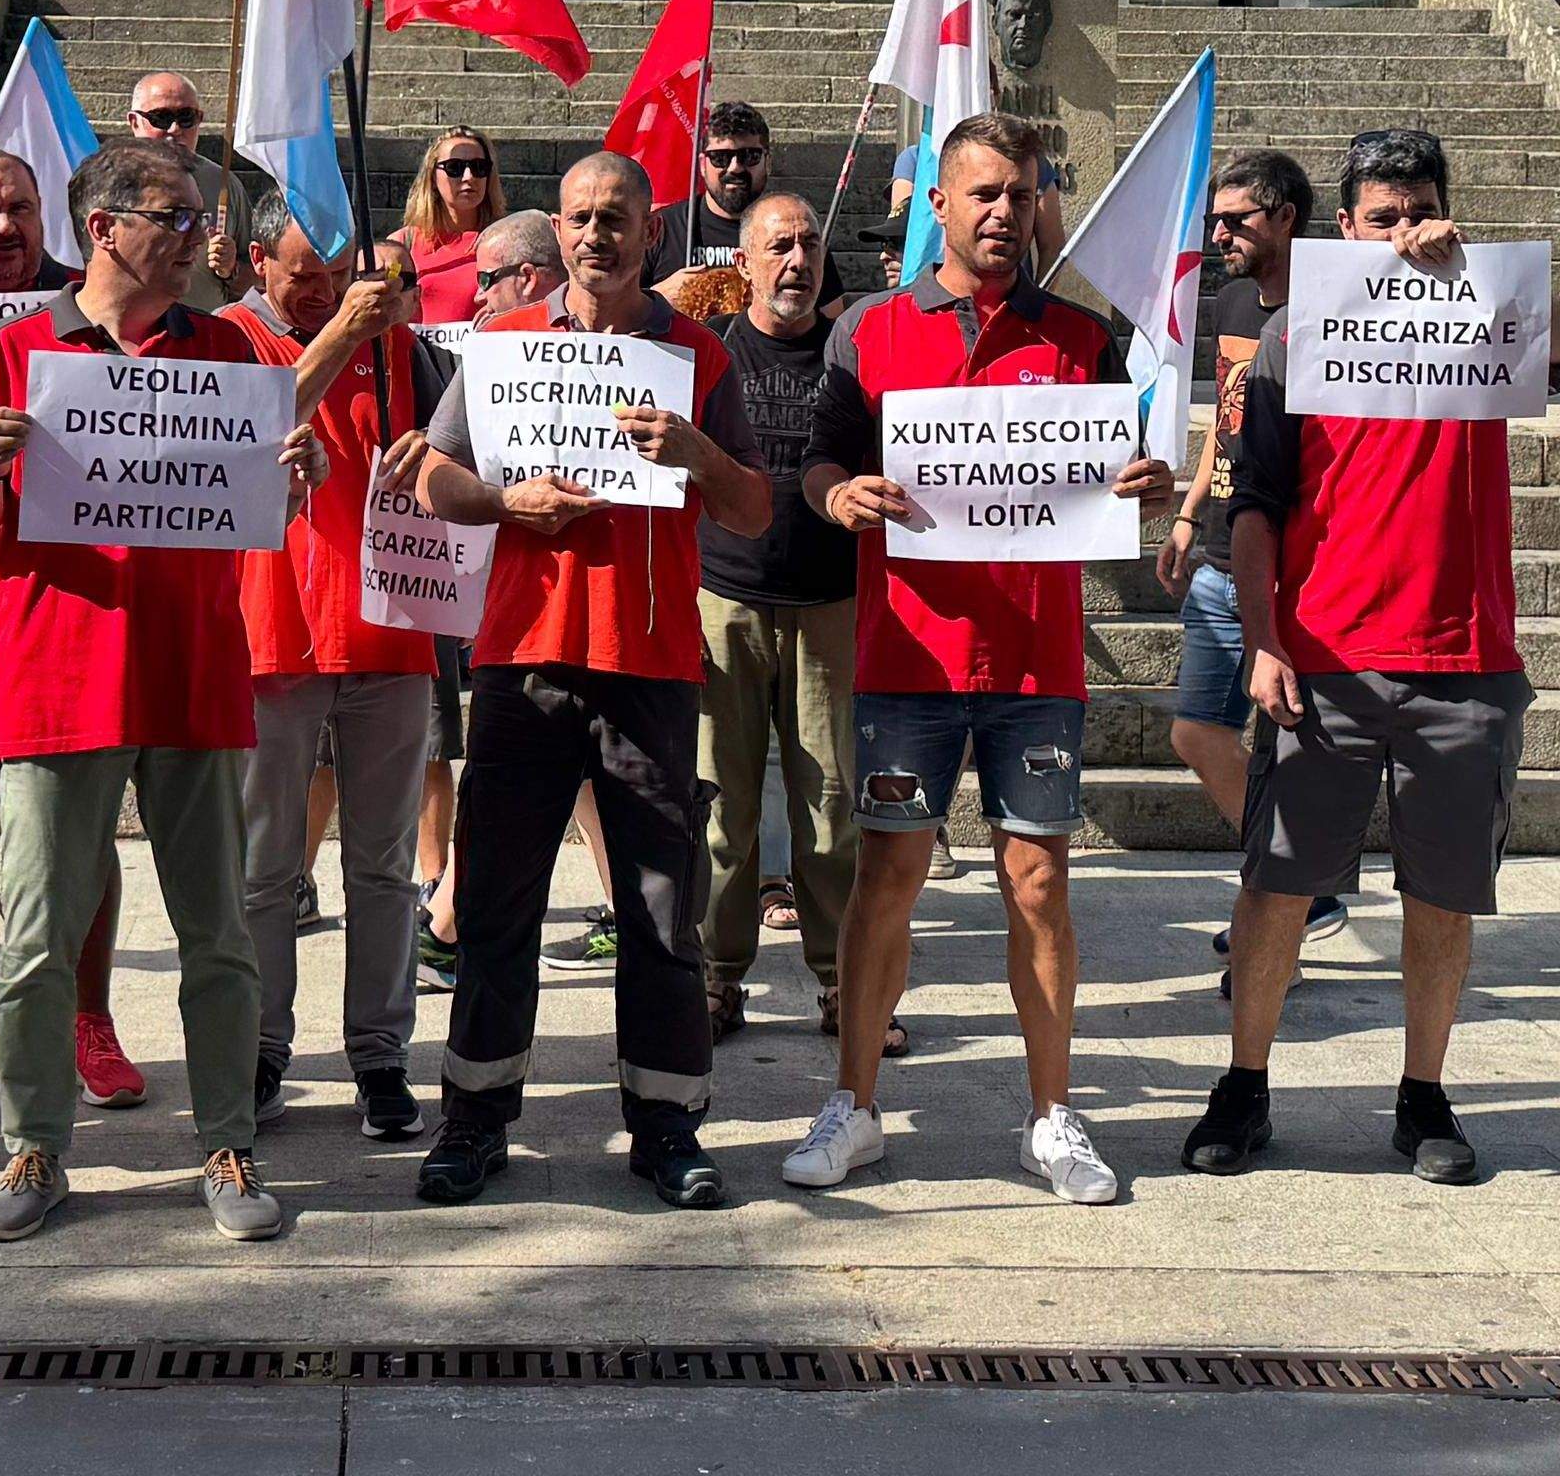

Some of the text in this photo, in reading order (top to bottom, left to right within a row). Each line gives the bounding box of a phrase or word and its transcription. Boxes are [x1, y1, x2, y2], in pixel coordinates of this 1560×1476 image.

[1365, 277, 1477, 302] VEOLIA
[1323, 319, 1516, 345] PRECARIZA E
[523, 341, 624, 367] VEOLIA
[107, 365, 221, 397] VEOLIA
[1325, 360, 1512, 385] DISCRIMINA
[491, 381, 656, 409] DISCRIMINA
[65, 408, 256, 443] DISCRIMINA
[508, 426, 629, 450] A XUNTA
[891, 419, 1130, 444] XUNTA ESCOITA
[86, 458, 229, 488] A XUNTA
[917, 462, 1105, 485] ESTAMOS EN
[73, 502, 236, 532] PARTICIPA
[968, 504, 1056, 527] LOITA
[455, 543, 464, 564] E
